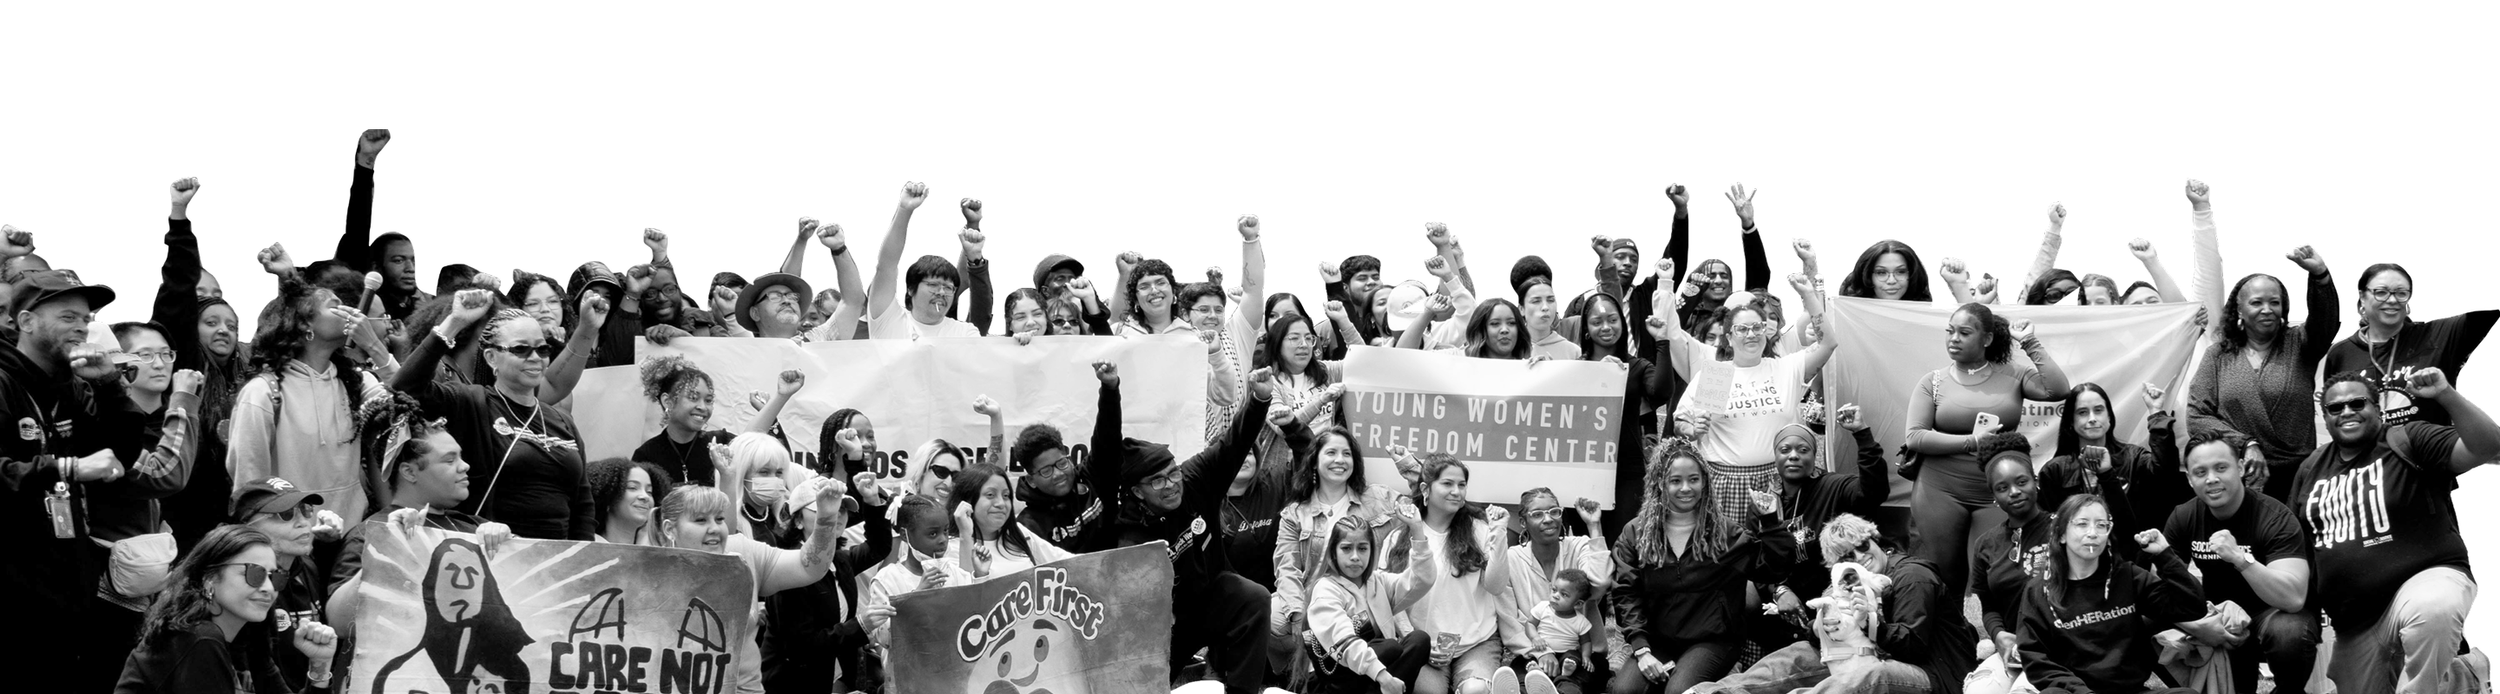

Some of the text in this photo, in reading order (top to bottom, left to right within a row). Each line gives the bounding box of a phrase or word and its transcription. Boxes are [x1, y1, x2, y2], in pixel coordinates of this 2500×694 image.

[1354, 391, 1608, 431] YOUNG WOMEN'S
[1728, 386, 1778, 399] EALING
[1728, 396, 1782, 410] JUSTICE
[1723, 408, 1784, 419] NETWORK
[1352, 422, 1617, 463] FREEDOM CENTER
[869, 450, 908, 479] OS
[2306, 457, 2390, 549] EQUITY
[958, 567, 1104, 662] Care First
[549, 641, 731, 694] CARE NOT
